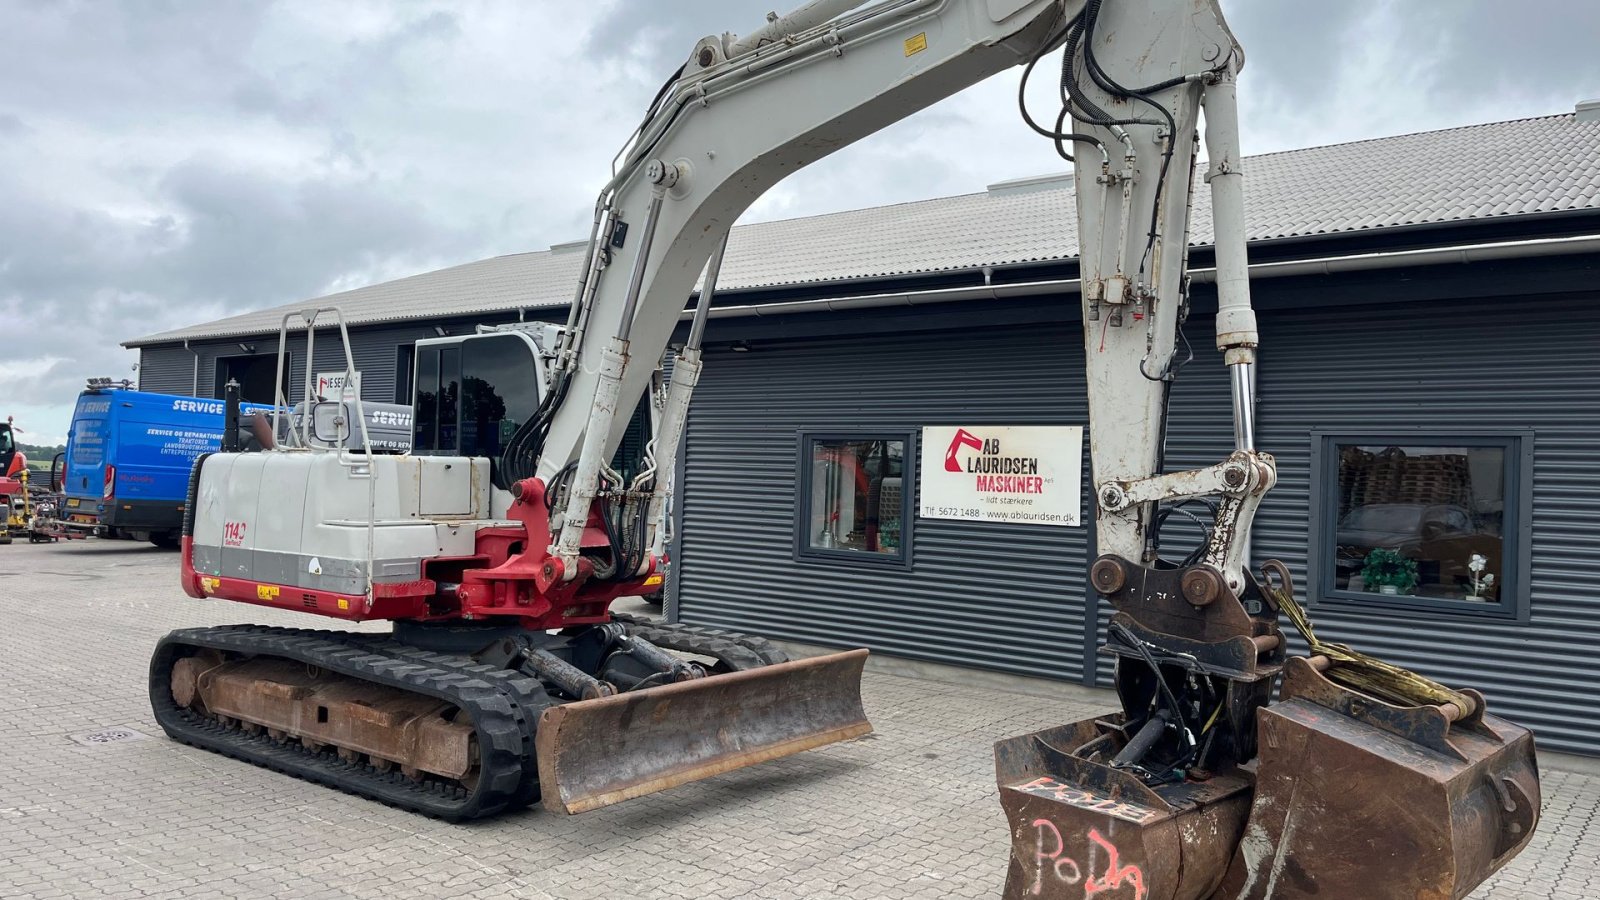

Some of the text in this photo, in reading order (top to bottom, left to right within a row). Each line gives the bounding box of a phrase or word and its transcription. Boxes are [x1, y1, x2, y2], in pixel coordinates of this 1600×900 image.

[84, 401, 111, 413] SERVICE
[172, 399, 224, 414] SERVICE
[147, 428, 173, 437] SERVICE
[982, 438, 1000, 455] AB
[967, 457, 1038, 475] LAURIDSEN
[976, 475, 1043, 494] MASKINER
[986, 496, 998, 504] lidt
[999, 497, 1033, 506] stærkere
[938, 507, 958, 517] 5672
[960, 508, 980, 518] 1488
[986, 509, 1075, 522] www.ablauridsen.dk
